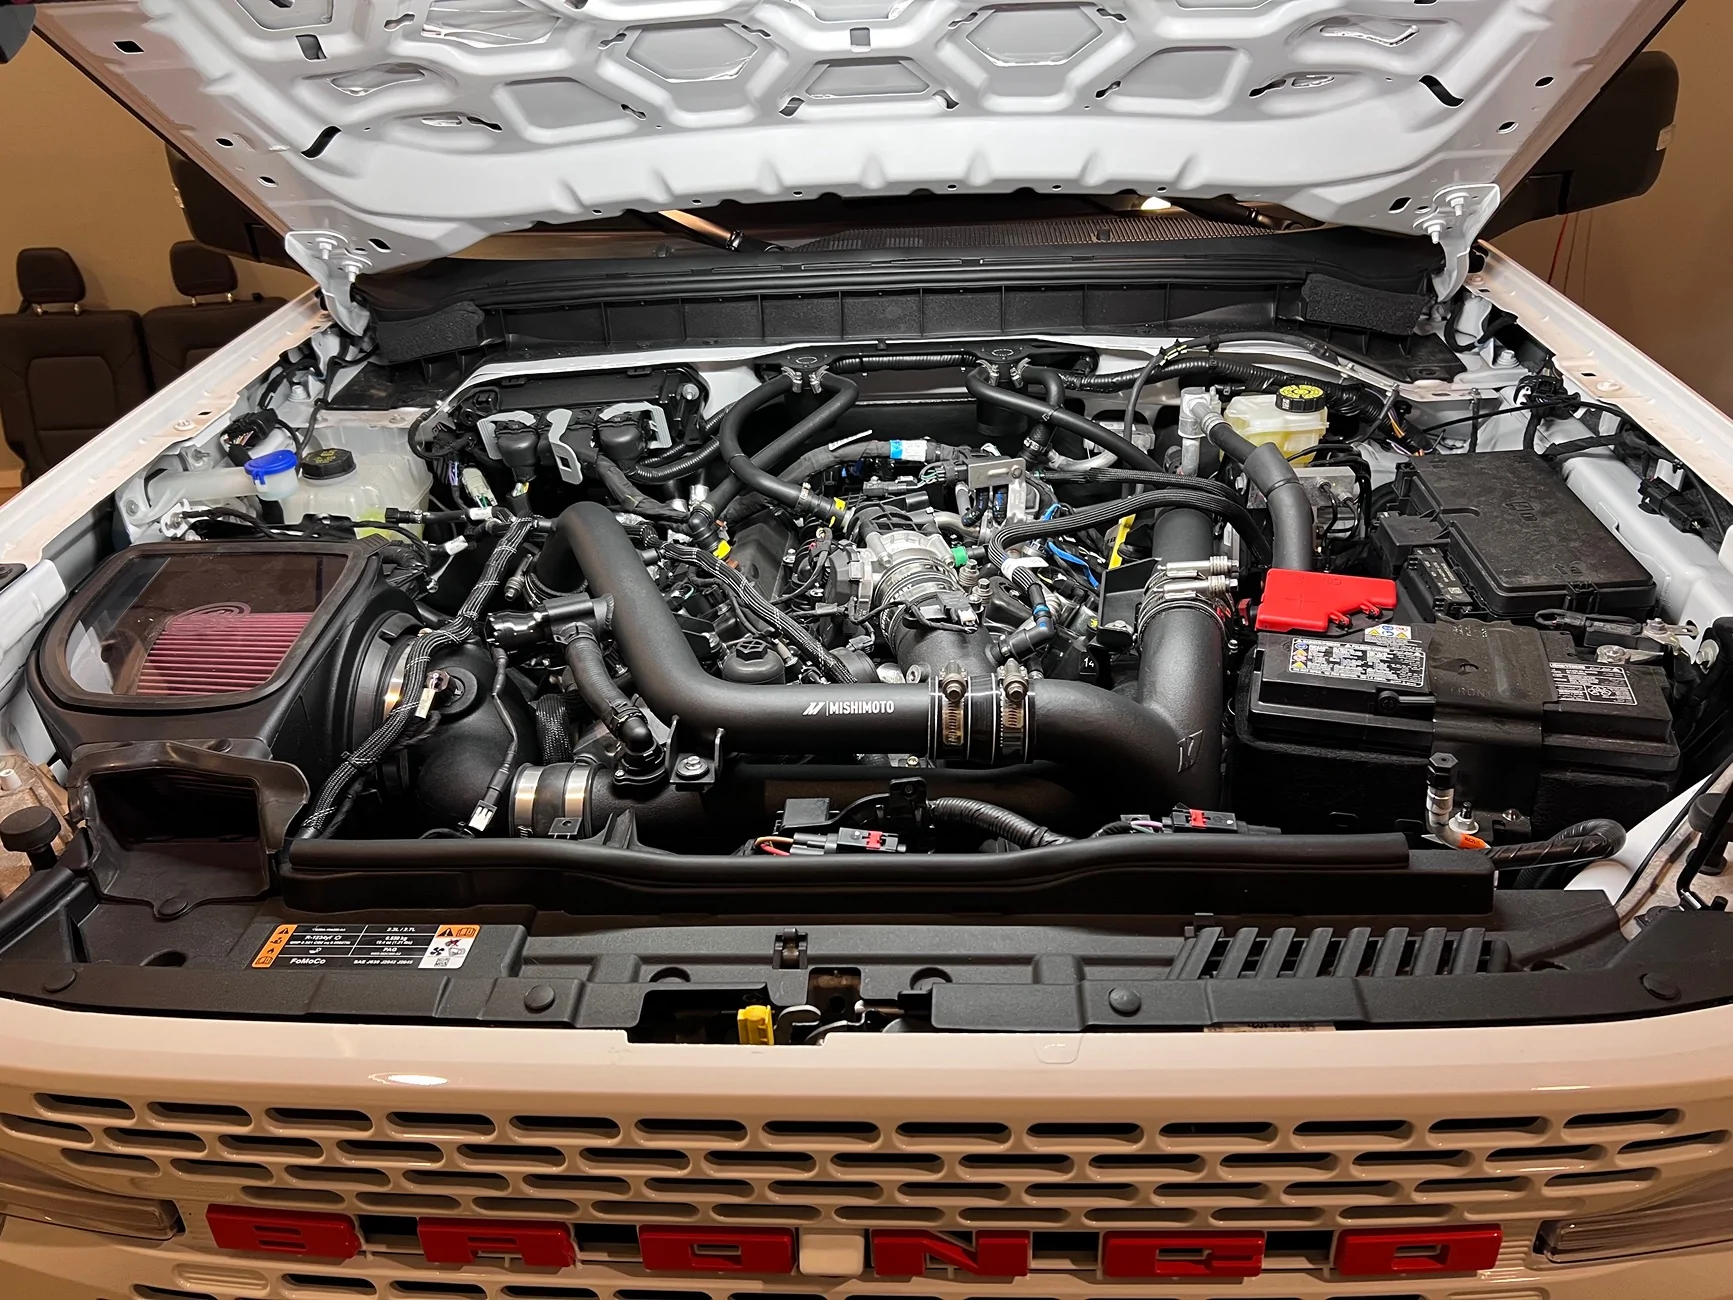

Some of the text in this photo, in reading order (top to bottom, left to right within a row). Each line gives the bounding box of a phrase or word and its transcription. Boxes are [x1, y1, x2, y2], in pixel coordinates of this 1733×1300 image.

[829, 700, 895, 715] MISHIMOTO
[289, 957, 326, 965] FoMoCo
[206, 1204, 1503, 1277] BRONCO
